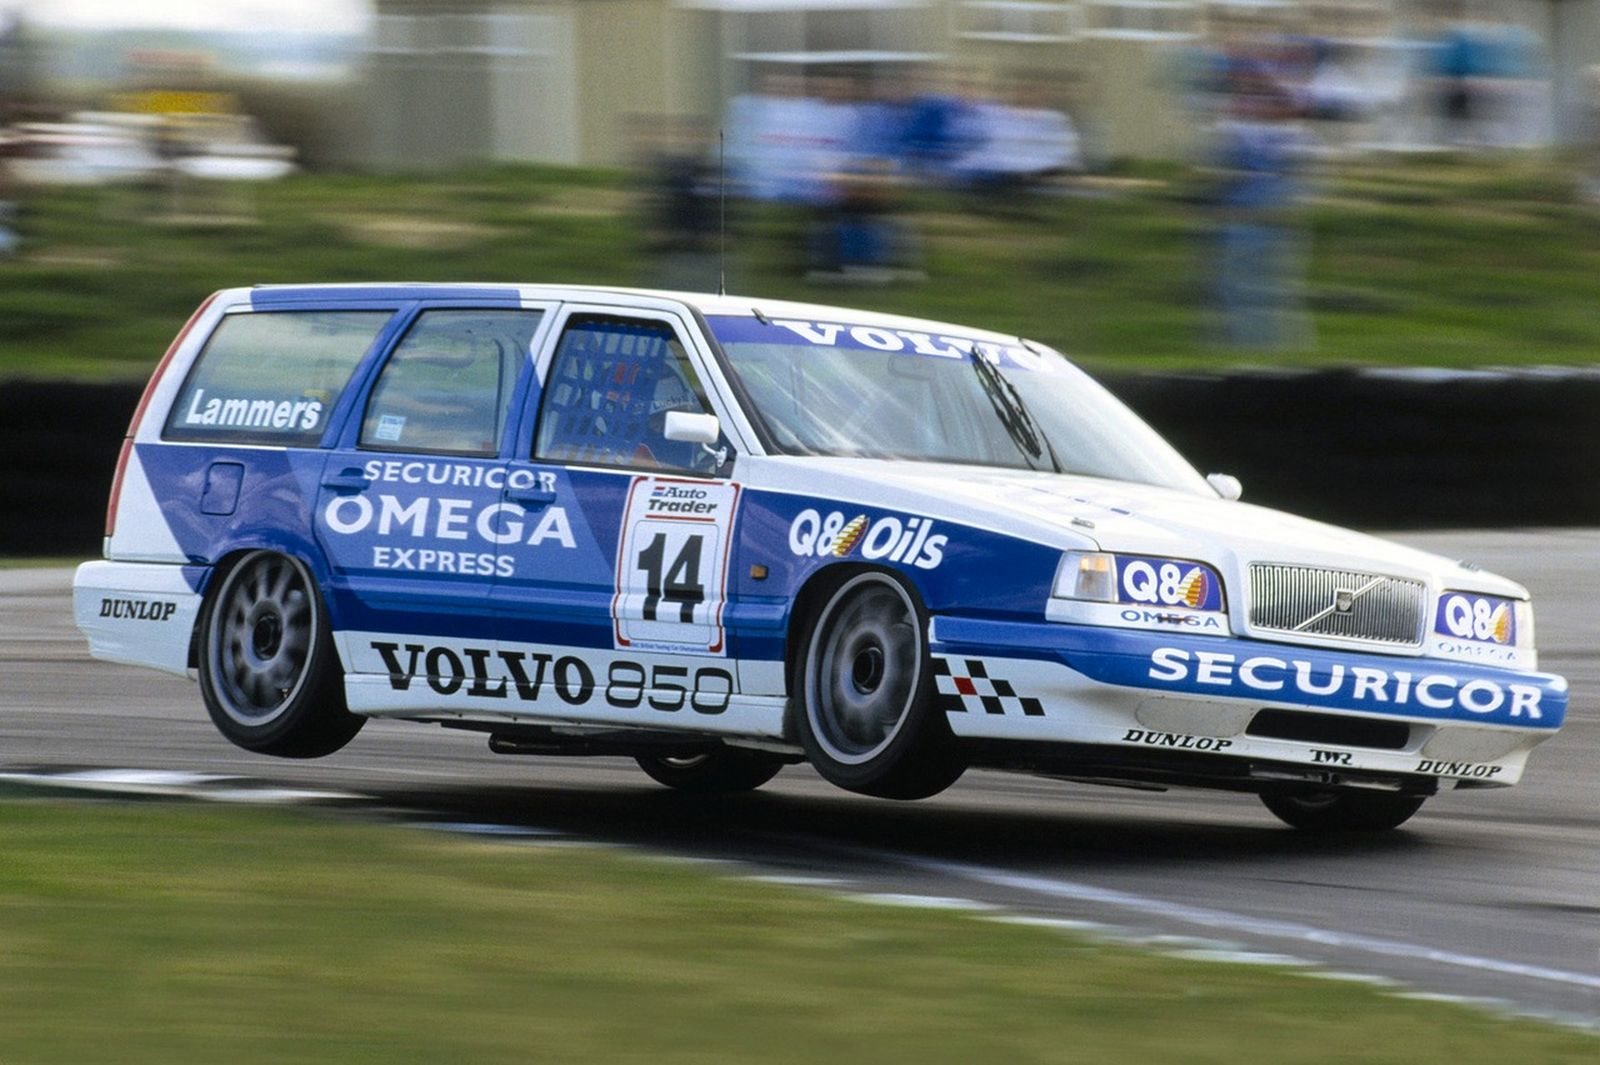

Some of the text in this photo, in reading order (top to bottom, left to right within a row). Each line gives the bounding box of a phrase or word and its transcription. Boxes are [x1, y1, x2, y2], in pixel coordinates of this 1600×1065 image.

[185, 389, 323, 431] Lammers
[363, 460, 557, 493] SECURICOR
[664, 486, 708, 499] Auto
[324, 495, 578, 549] OMEGA
[648, 499, 717, 514] Trader
[789, 508, 949, 570] Q8 Oils
[372, 547, 515, 578] EXPRESS
[637, 532, 705, 624] 14
[1123, 560, 1181, 605] Q8
[99, 598, 177, 621] DUNLOP
[1120, 609, 1220, 629] OMEGA
[1445, 595, 1492, 641] Q8
[1438, 641, 1517, 661] OMA
[370, 641, 734, 716] VOLVO 850
[1148, 646, 1543, 720] SECURICOR
[1122, 729, 1233, 754] DUNLOP
[1310, 749, 1353, 766] TWR
[1414, 760, 1503, 778] DUNLOP
